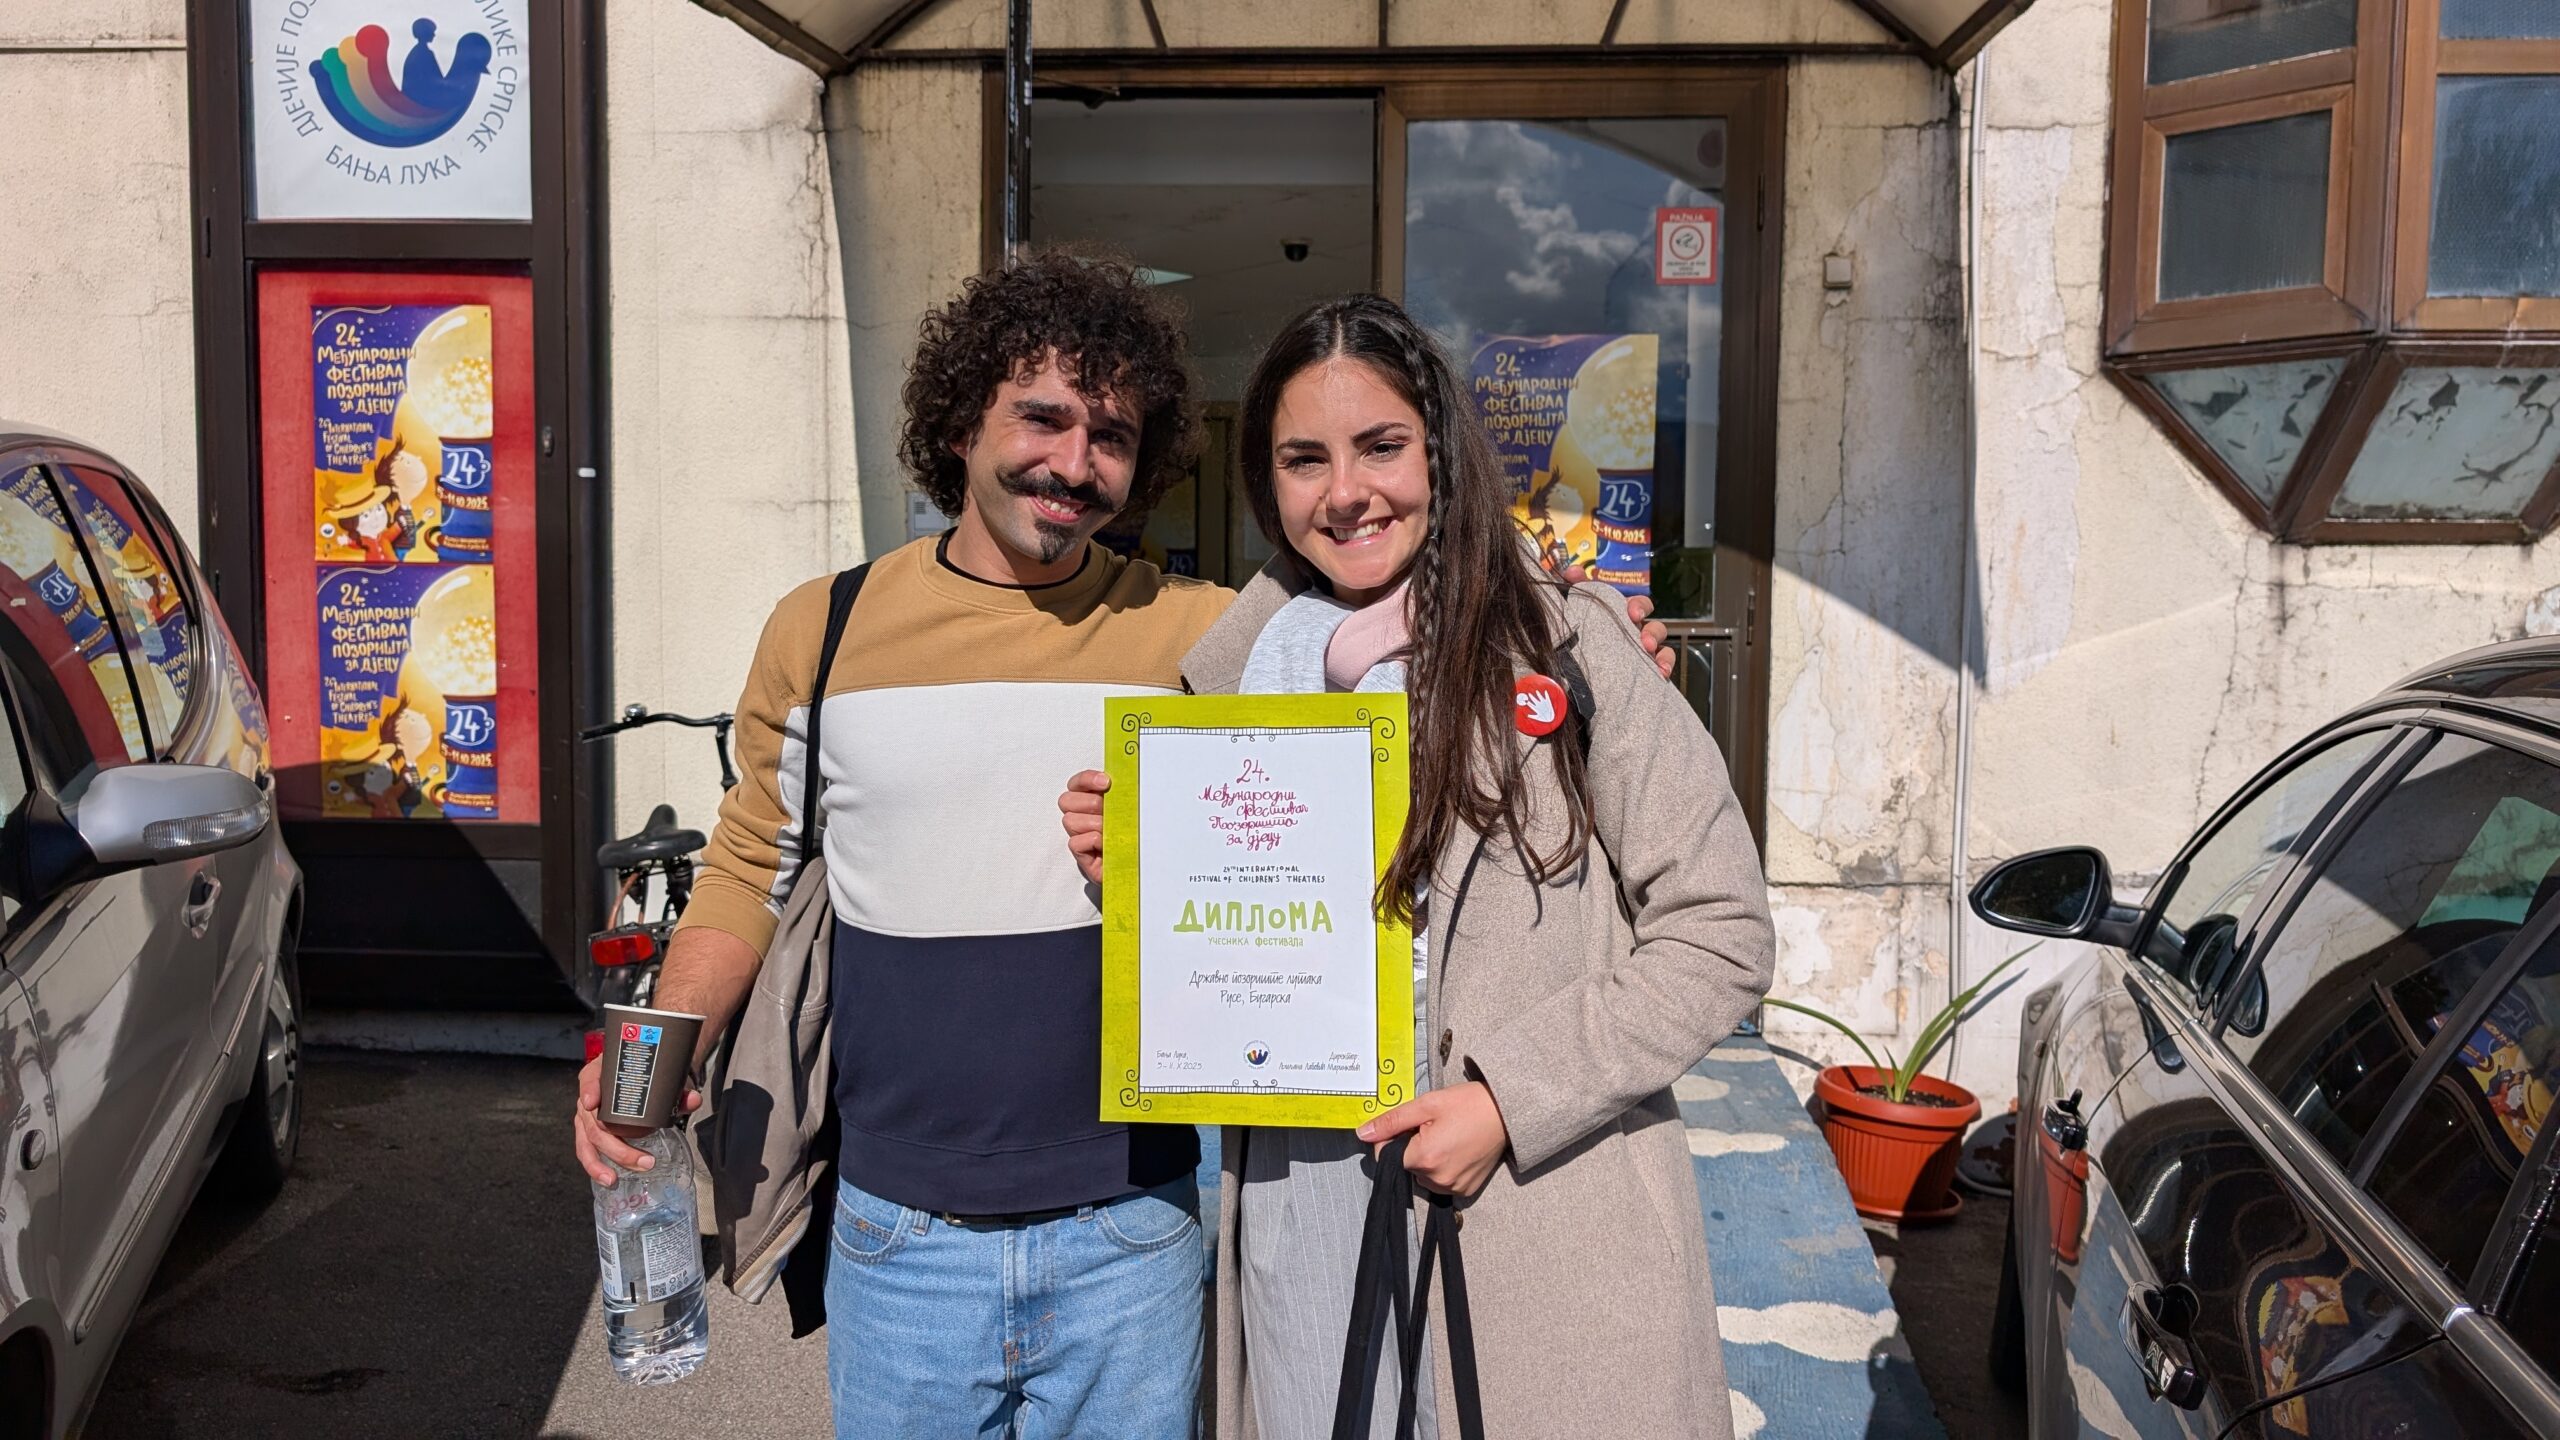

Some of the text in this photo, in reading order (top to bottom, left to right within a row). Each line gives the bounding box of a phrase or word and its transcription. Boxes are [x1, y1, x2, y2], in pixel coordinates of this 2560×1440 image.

[276, 0, 323, 137] ДЈЕЧИЈЕ ПО
[467, 66, 518, 153] СРПСКЕ
[326, 145, 461, 184] БАЊА ЛУКА
[327, 363, 403, 383] ФЕСТИВАЛ
[328, 380, 407, 399] ПОЗОРИШТА
[340, 400, 354, 413] ЗА
[1484, 394, 1564, 413] ФЕСТИВАЛ
[446, 452, 477, 485] 24
[1603, 484, 1635, 517] 24
[331, 622, 407, 642] ФЕСТИВАЛ
[333, 638, 411, 658] ПОЗОРИШТА
[345, 659, 359, 672] ЗА
[450, 710, 480, 742] 24
[1236, 758, 1270, 784] 24.
[1189, 875, 1222, 883] FESTIVAL
[1238, 875, 1280, 883] CHILDREN'S
[1286, 875, 1326, 883] THEATRES
[1237, 865, 1300, 873] INTERNATIONAL
[1173, 899, 1333, 933] ДИПЛОМА
[1188, 969, 1229, 988] Државно
[1220, 989, 1291, 1008] Русе, Бугарска
